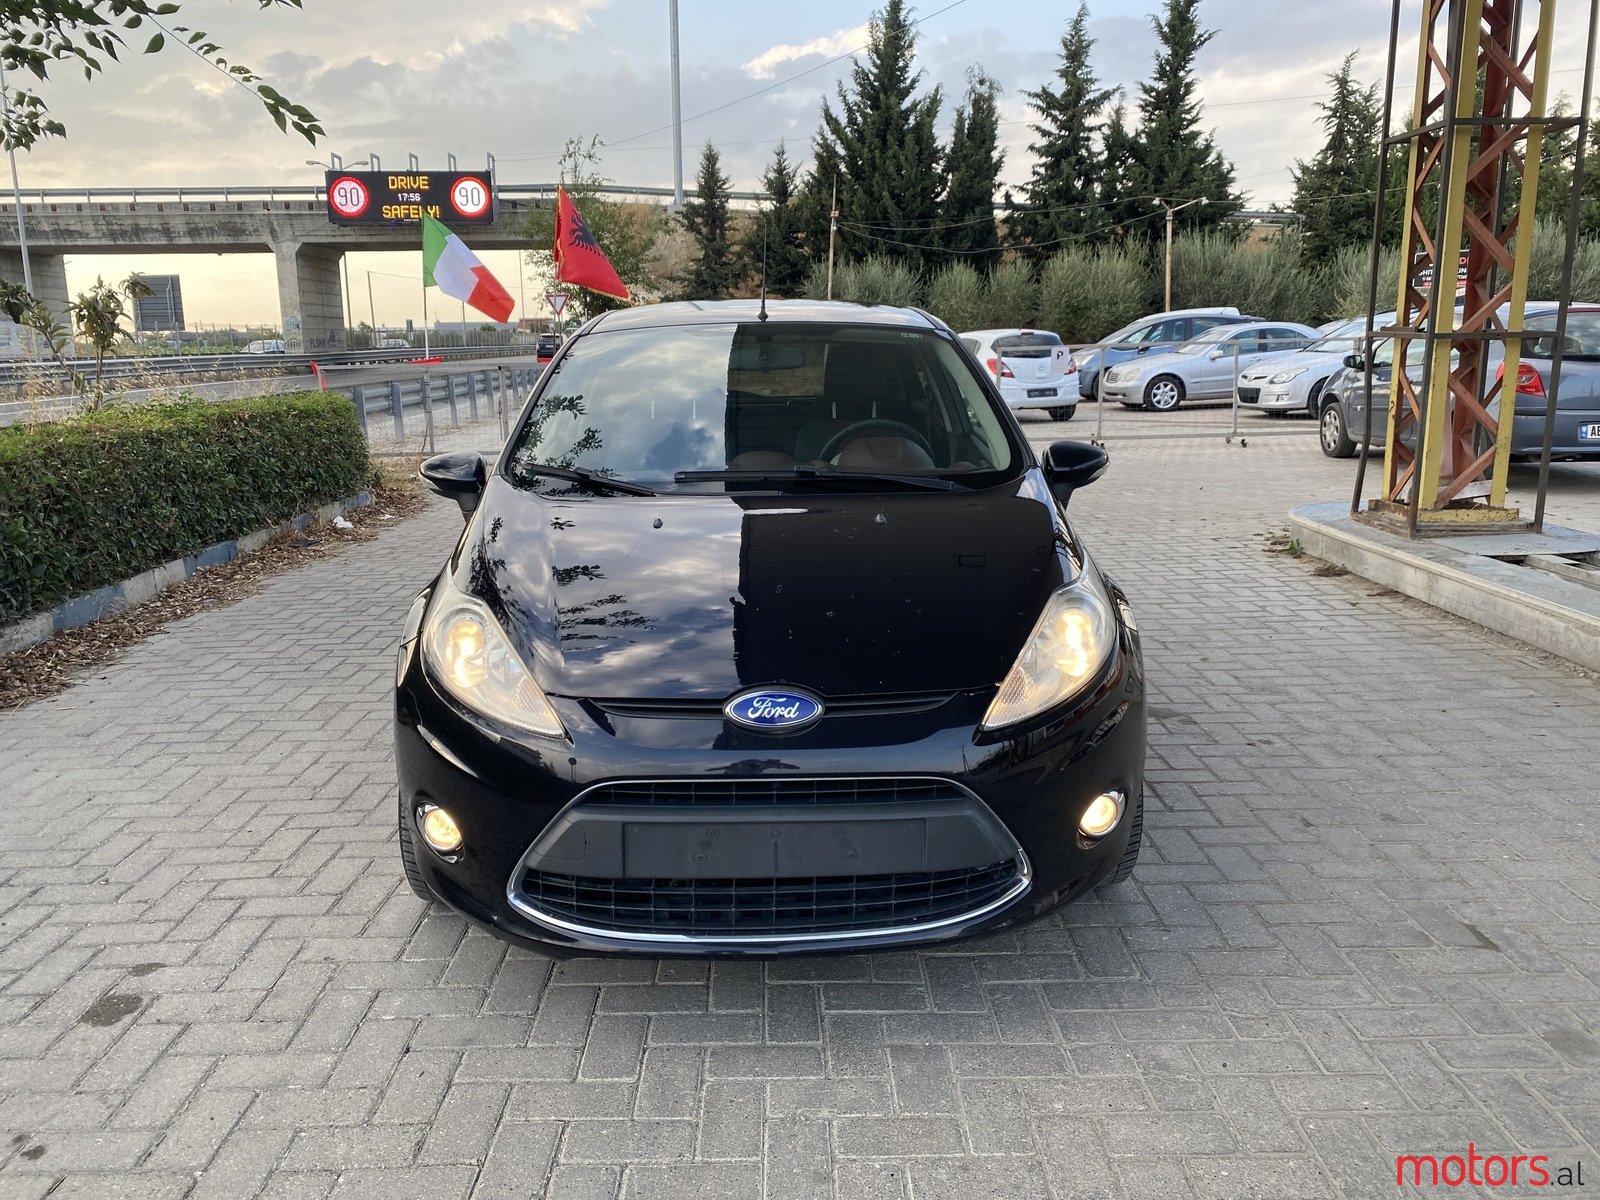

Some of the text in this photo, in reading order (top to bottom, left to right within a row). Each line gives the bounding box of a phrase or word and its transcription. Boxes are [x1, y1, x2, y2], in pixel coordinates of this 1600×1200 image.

[388, 175, 429, 190] DRIVE
[338, 186, 359, 207] 90
[397, 192, 421, 202] 17:56
[458, 186, 481, 207] 90
[747, 697, 800, 719] Ford
